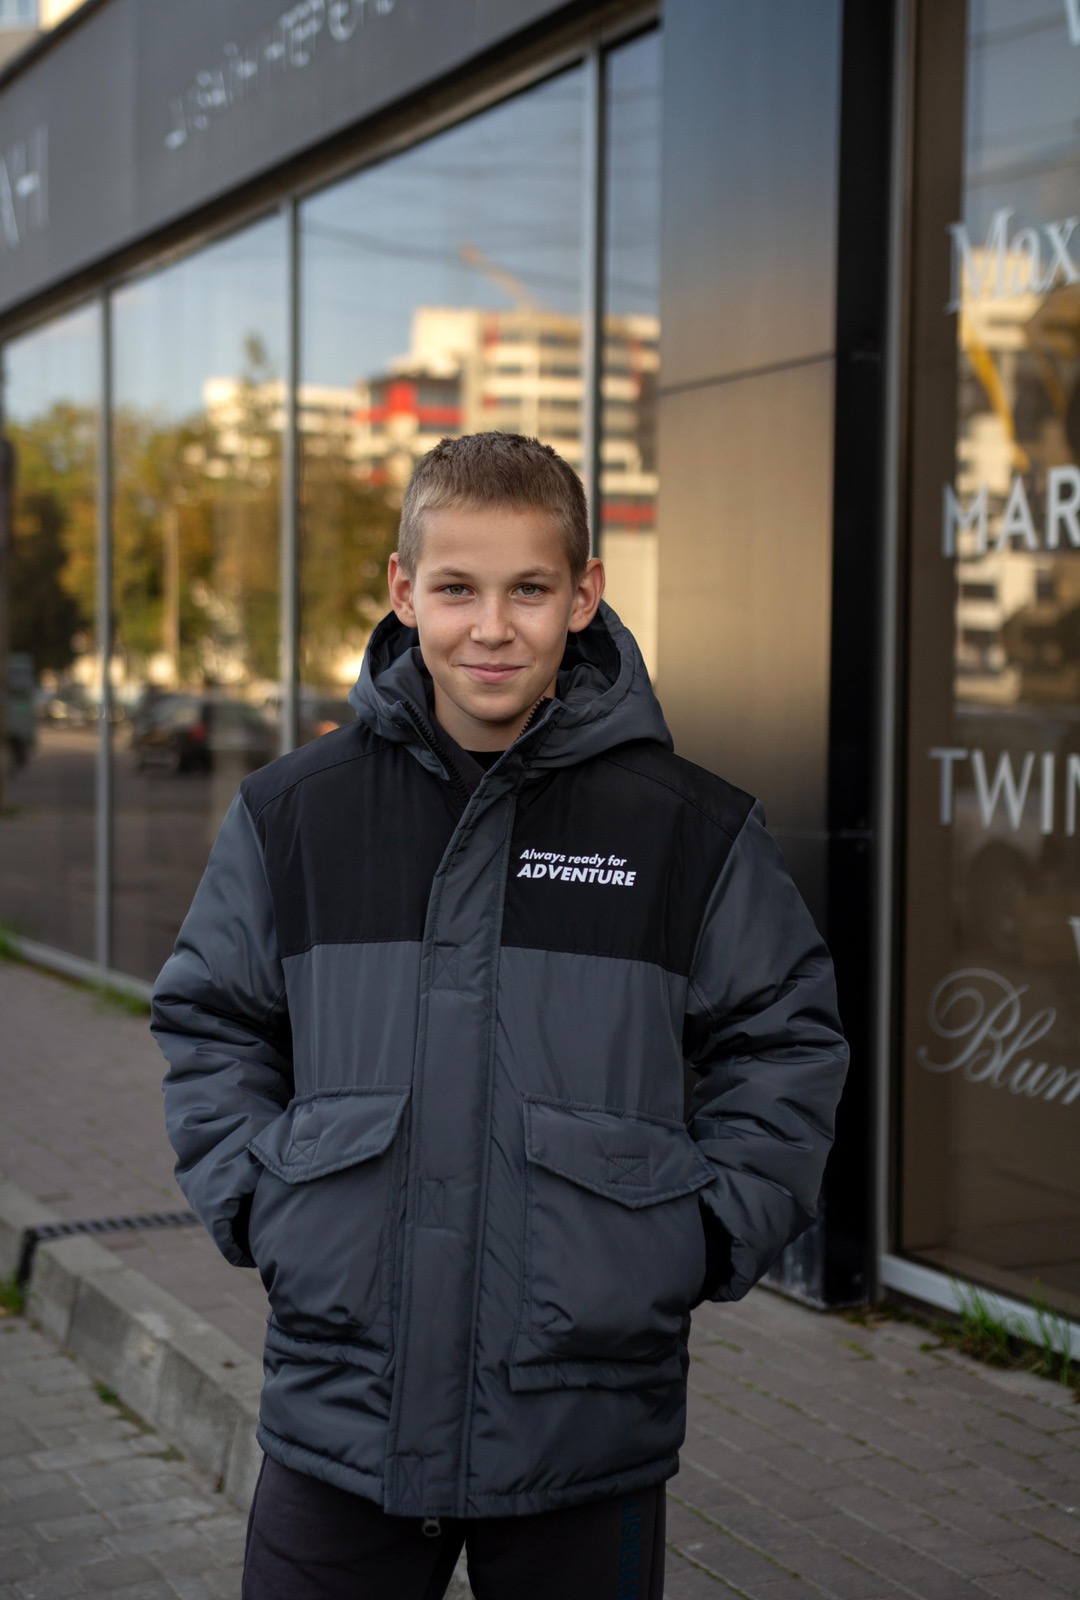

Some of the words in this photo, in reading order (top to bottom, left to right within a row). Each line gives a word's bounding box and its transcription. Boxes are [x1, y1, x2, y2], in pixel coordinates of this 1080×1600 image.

[941, 464, 1080, 558] MAR
[519, 848, 566, 863] Always
[568, 853, 605, 867] ready
[607, 855, 627, 867] for
[517, 863, 636, 886] ADVENTURE
